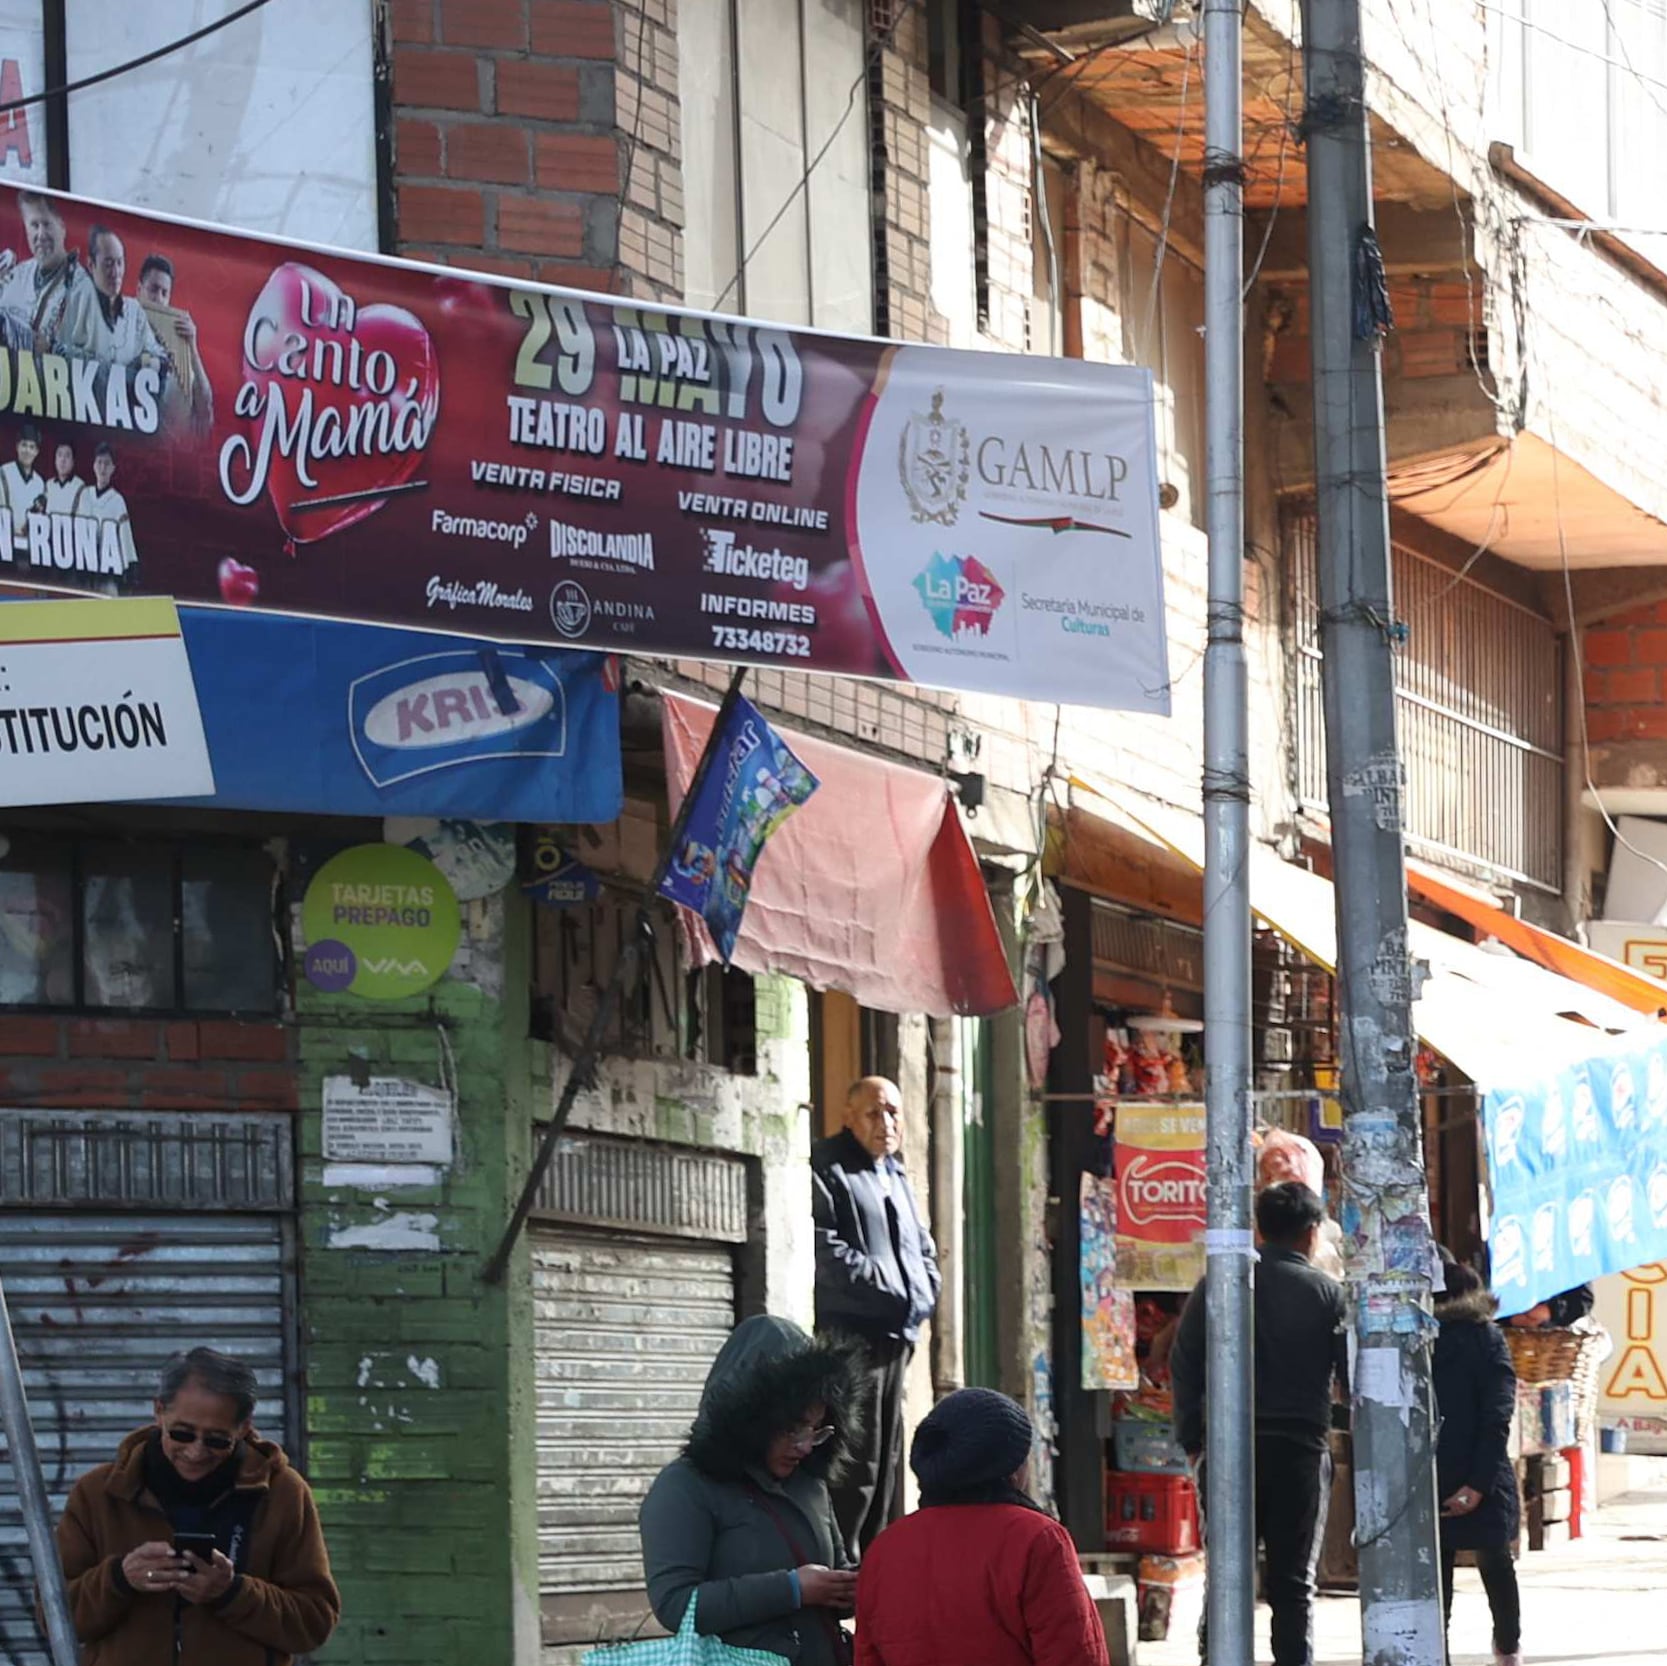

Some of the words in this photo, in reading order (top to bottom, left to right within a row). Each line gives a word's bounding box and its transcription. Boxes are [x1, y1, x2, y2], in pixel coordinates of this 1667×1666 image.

[300, 280, 356, 332] Un
[244, 315, 397, 394] Canto
[510, 293, 596, 396] 29
[613, 306, 803, 428] MAYO
[613, 325, 650, 372] LA
[658, 332, 711, 382] PAZ
[234, 380, 268, 417] a
[219, 376, 438, 505] Mamá
[507, 395, 605, 455] TEATRO
[614, 412, 648, 461] AL
[656, 418, 715, 471] AIRE
[722, 428, 793, 482] LIBRE
[470, 460, 545, 490] VENTA
[548, 473, 622, 500] FISICA
[976, 436, 1129, 501] GAMLP
[431, 509, 528, 549] Farmacorp
[678, 490, 748, 520] VENTA
[751, 501, 829, 531] ONLINE
[549, 518, 655, 571] DISCOLANDIA
[704, 528, 810, 590] Ticketeg
[701, 592, 816, 625] INFORMES
[924, 571, 952, 601] La
[955, 575, 993, 607] Paz
[593, 599, 656, 621] ANDINA
[1060, 616, 1111, 638] Culturas
[1078, 598, 1130, 622] Municipal
[1132, 608, 1145, 623] de
[711, 625, 812, 657] 73348732
[0, 690, 168, 755] TITUCIÓN
[331, 882, 434, 906] TARJETAS
[332, 904, 432, 928] PREPAGO
